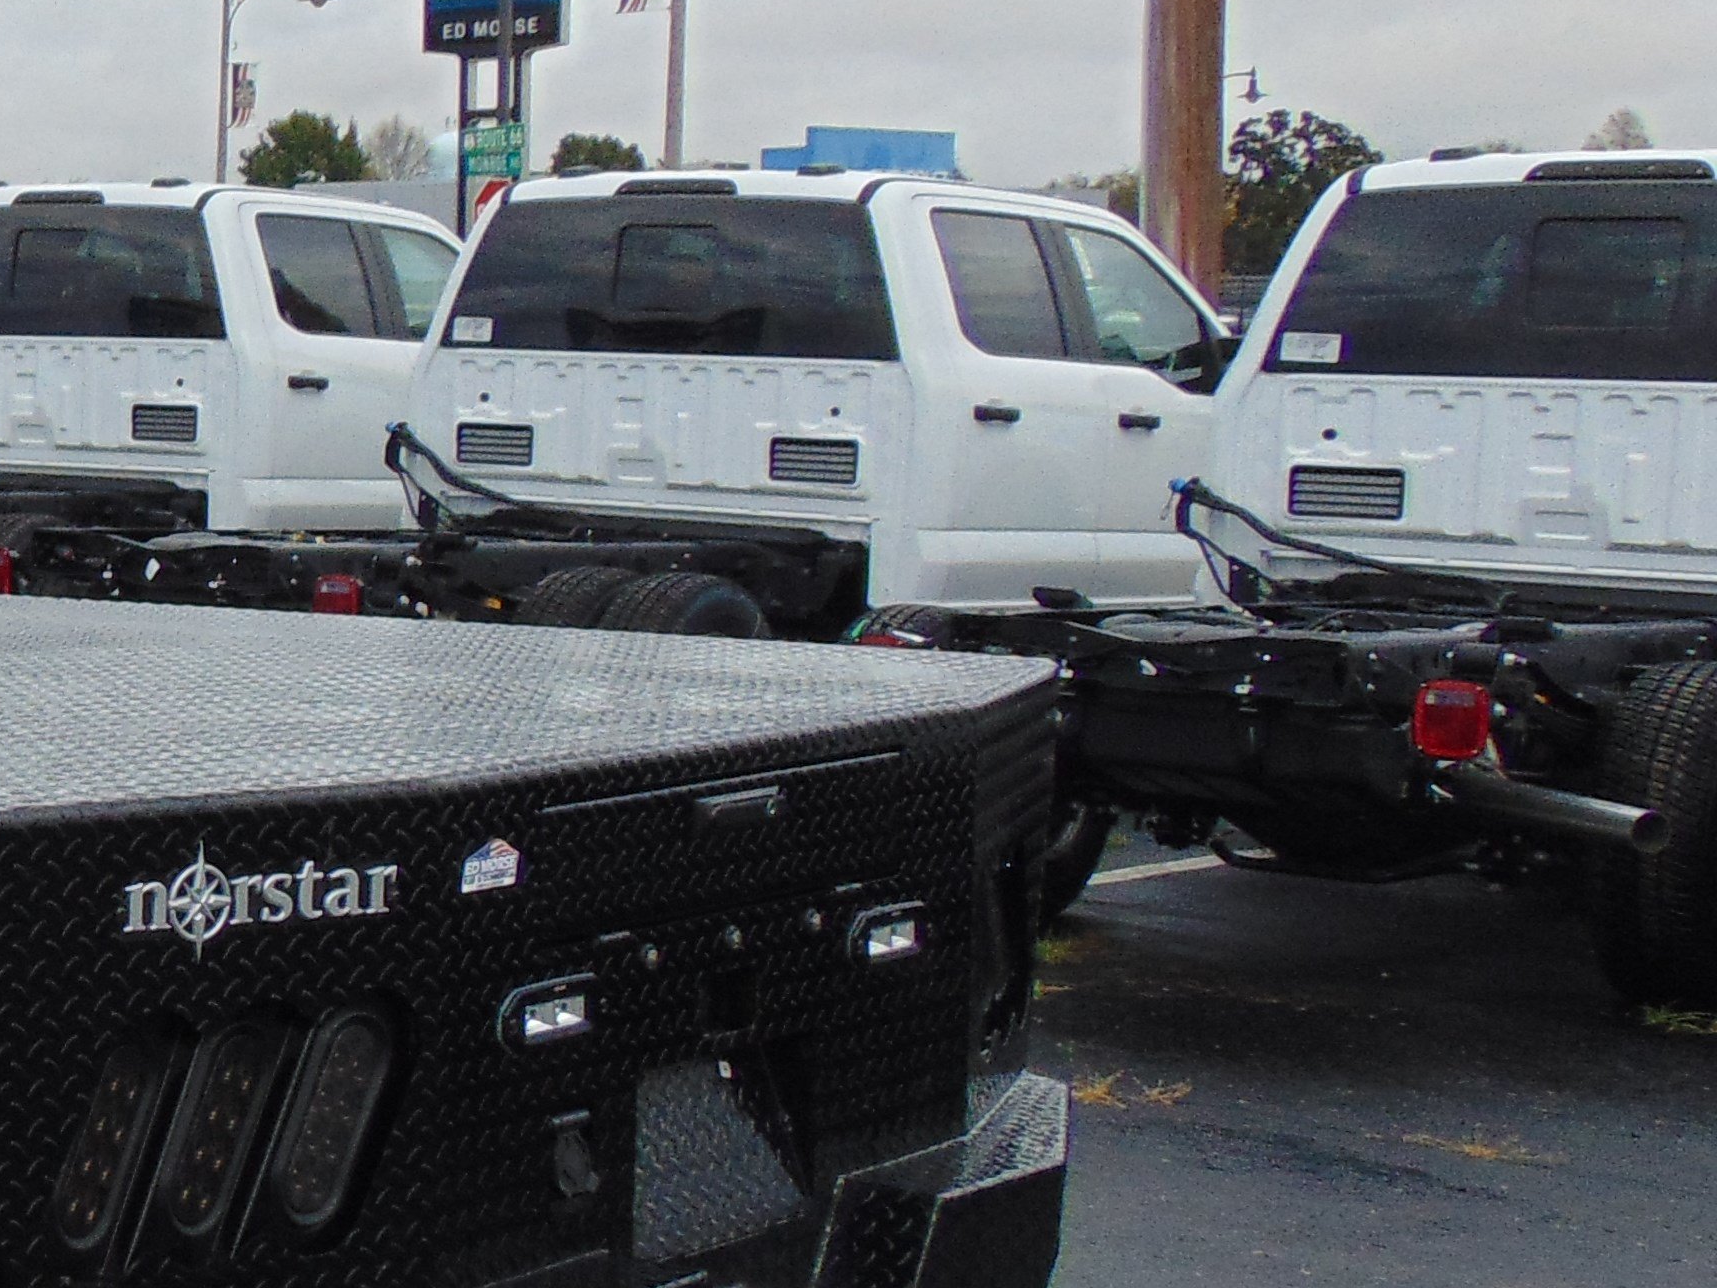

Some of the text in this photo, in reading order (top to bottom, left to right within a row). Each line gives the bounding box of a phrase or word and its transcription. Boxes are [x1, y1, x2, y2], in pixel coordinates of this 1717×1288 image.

[442, 15, 541, 40] ED MOSE
[123, 851, 398, 950] norstar
